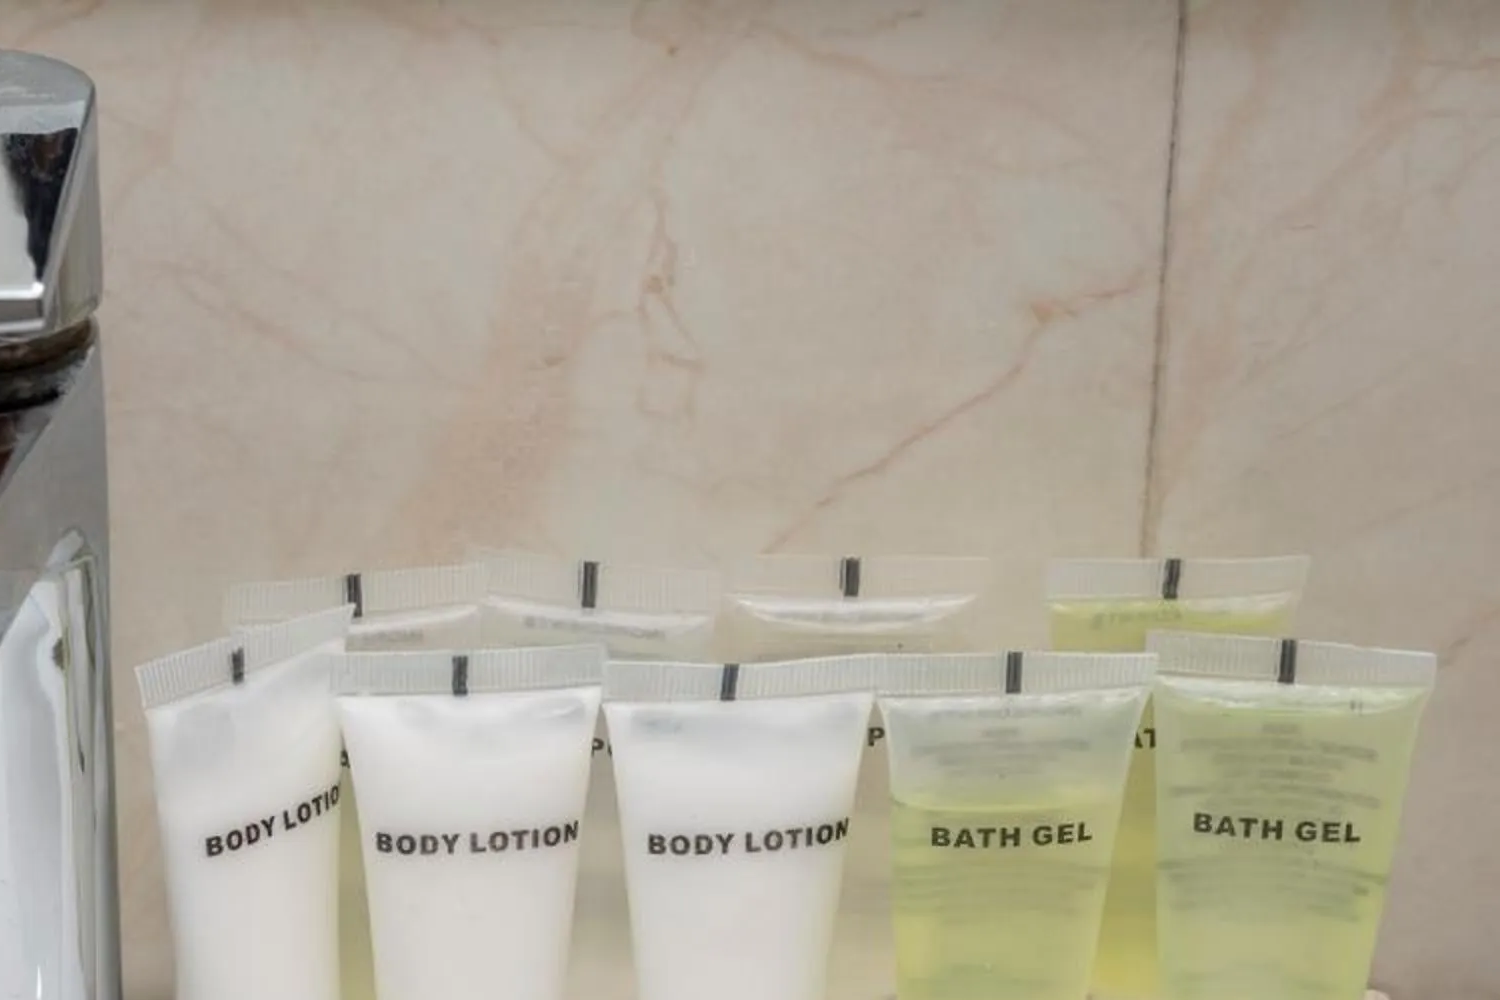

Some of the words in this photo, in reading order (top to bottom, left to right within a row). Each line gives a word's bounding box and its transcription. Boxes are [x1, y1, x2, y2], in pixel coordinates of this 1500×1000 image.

[205, 814, 275, 857] BODY
[282, 783, 342, 830] LOTIO
[375, 831, 460, 855] BODY
[469, 819, 579, 852] LOTION
[648, 832, 735, 855] BODY
[745, 817, 850, 852] LOTION
[931, 826, 1021, 849] BATH
[1032, 821, 1093, 846] GEL
[1193, 812, 1284, 841] BATH
[1294, 820, 1362, 843] GEL
